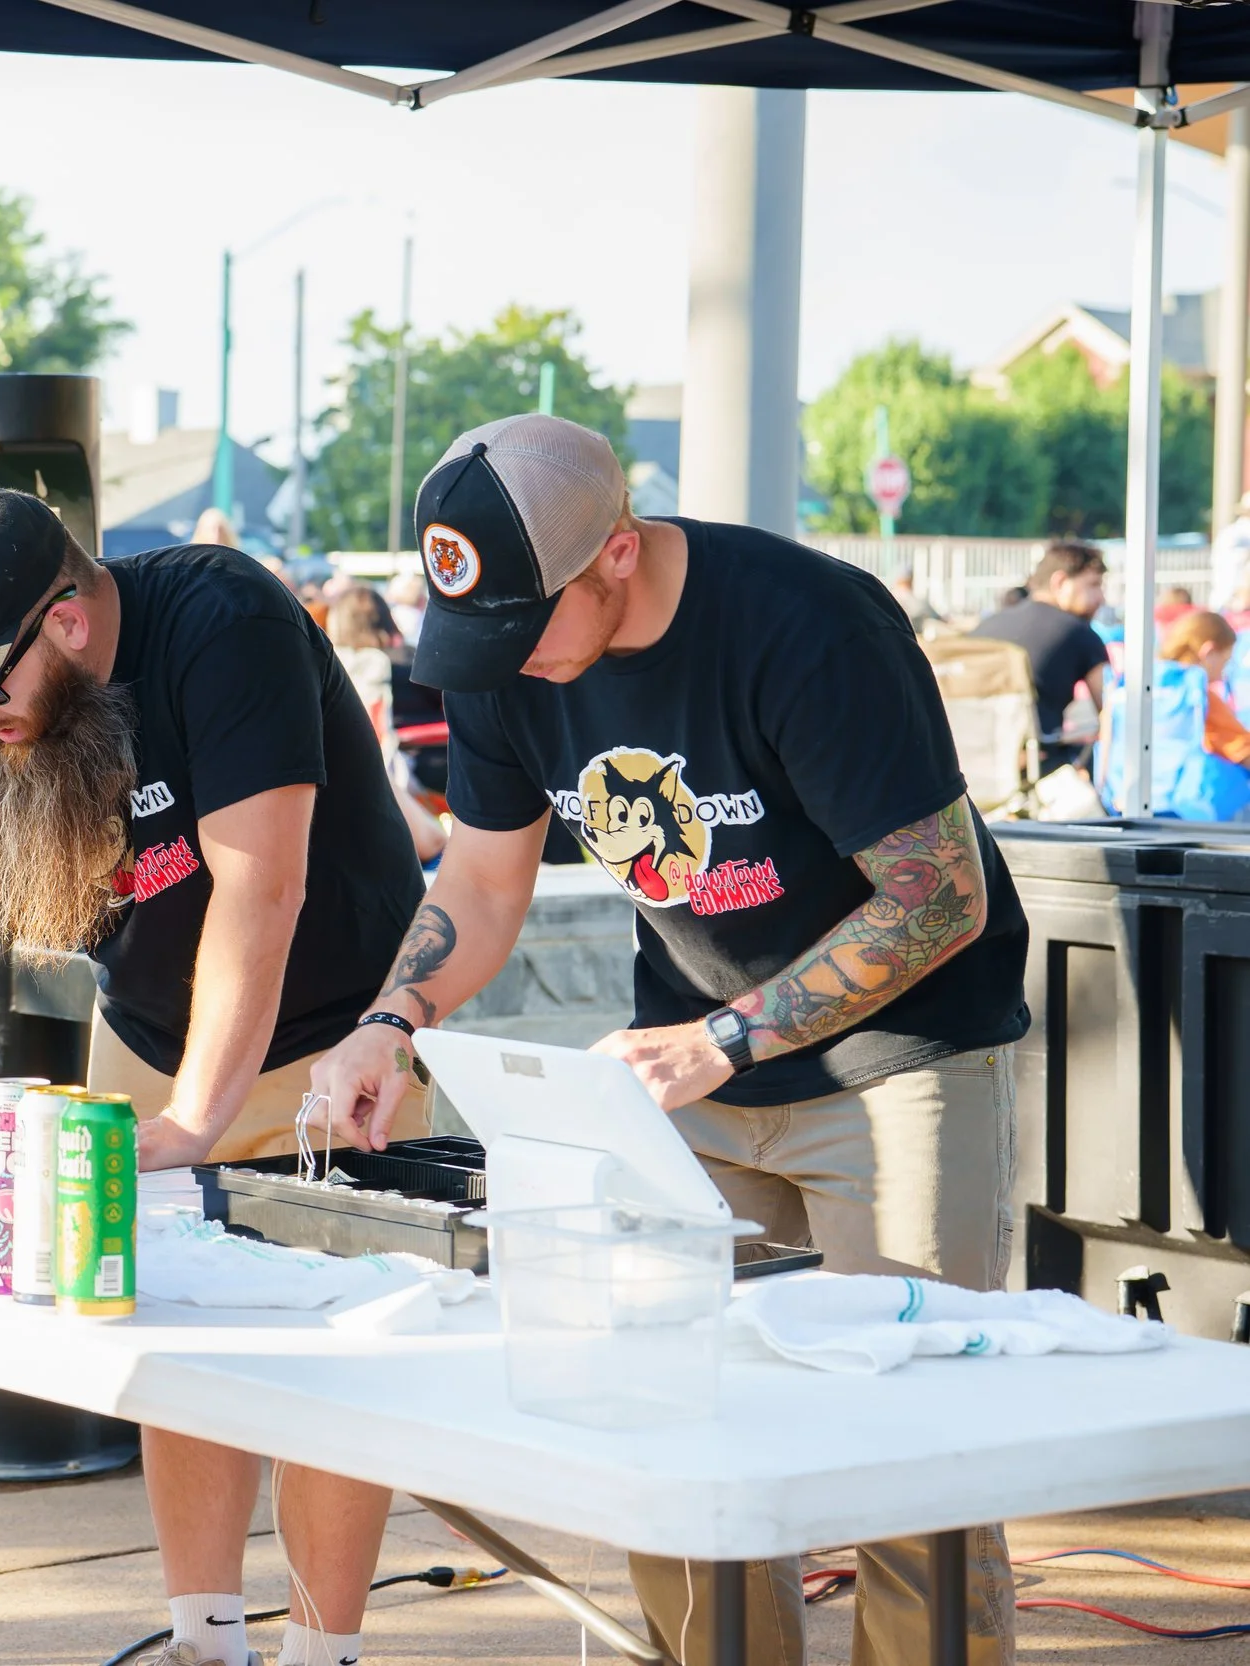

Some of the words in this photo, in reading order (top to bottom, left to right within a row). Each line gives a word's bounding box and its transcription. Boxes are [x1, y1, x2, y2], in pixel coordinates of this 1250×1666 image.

[555, 795, 601, 822] WOF
[677, 795, 759, 824] DOWN
[689, 877, 784, 915] COMMONS
